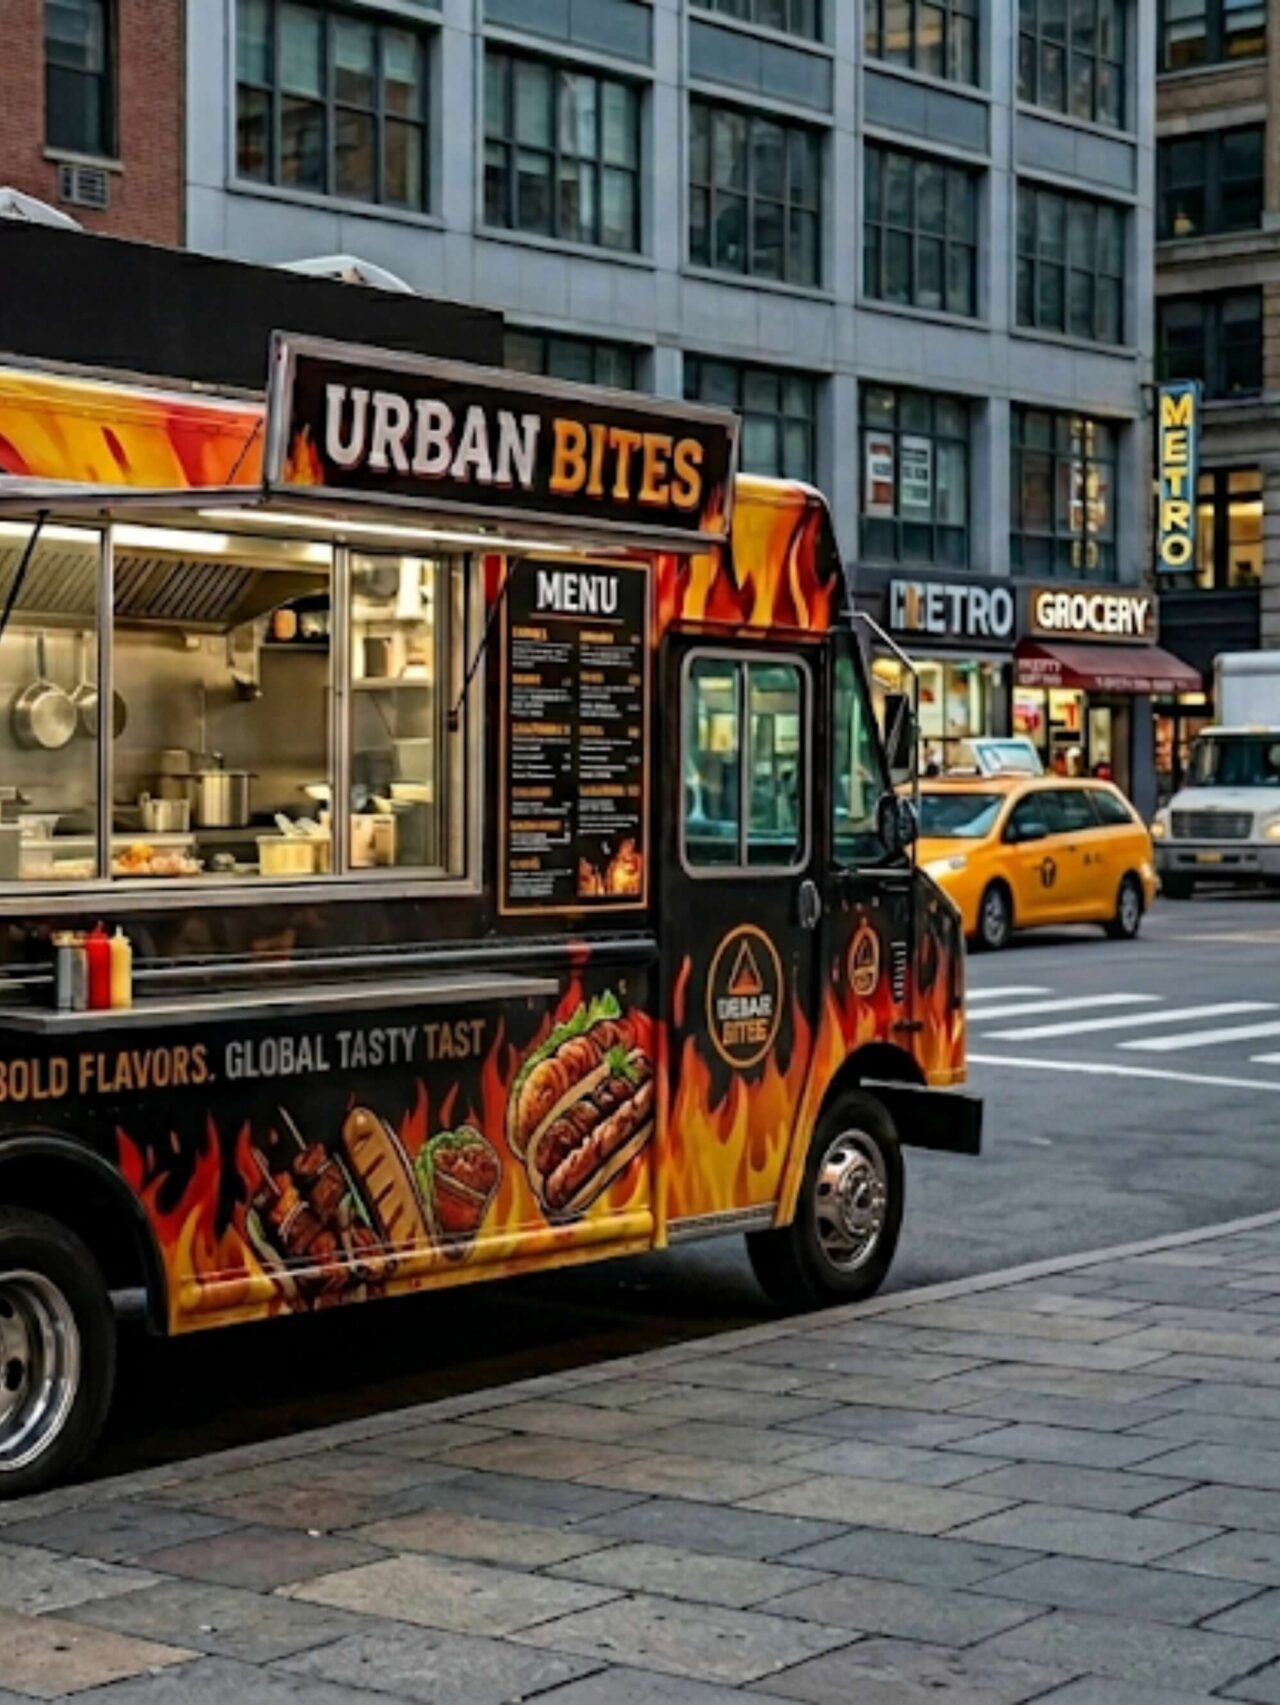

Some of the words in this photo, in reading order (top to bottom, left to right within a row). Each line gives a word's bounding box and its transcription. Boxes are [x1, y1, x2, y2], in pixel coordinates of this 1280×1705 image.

[326, 384, 541, 487] URBAN
[549, 420, 704, 508] BITES
[1161, 393, 1194, 566] METRO
[536, 570, 618, 614] MENU
[1037, 593, 1148, 635] GROCERY
[79, 1044, 216, 1095] FLAVORS.
[225, 1034, 330, 1080] GLOBAL
[336, 1026, 418, 1069] TASTY
[424, 1019, 486, 1061] TAST
